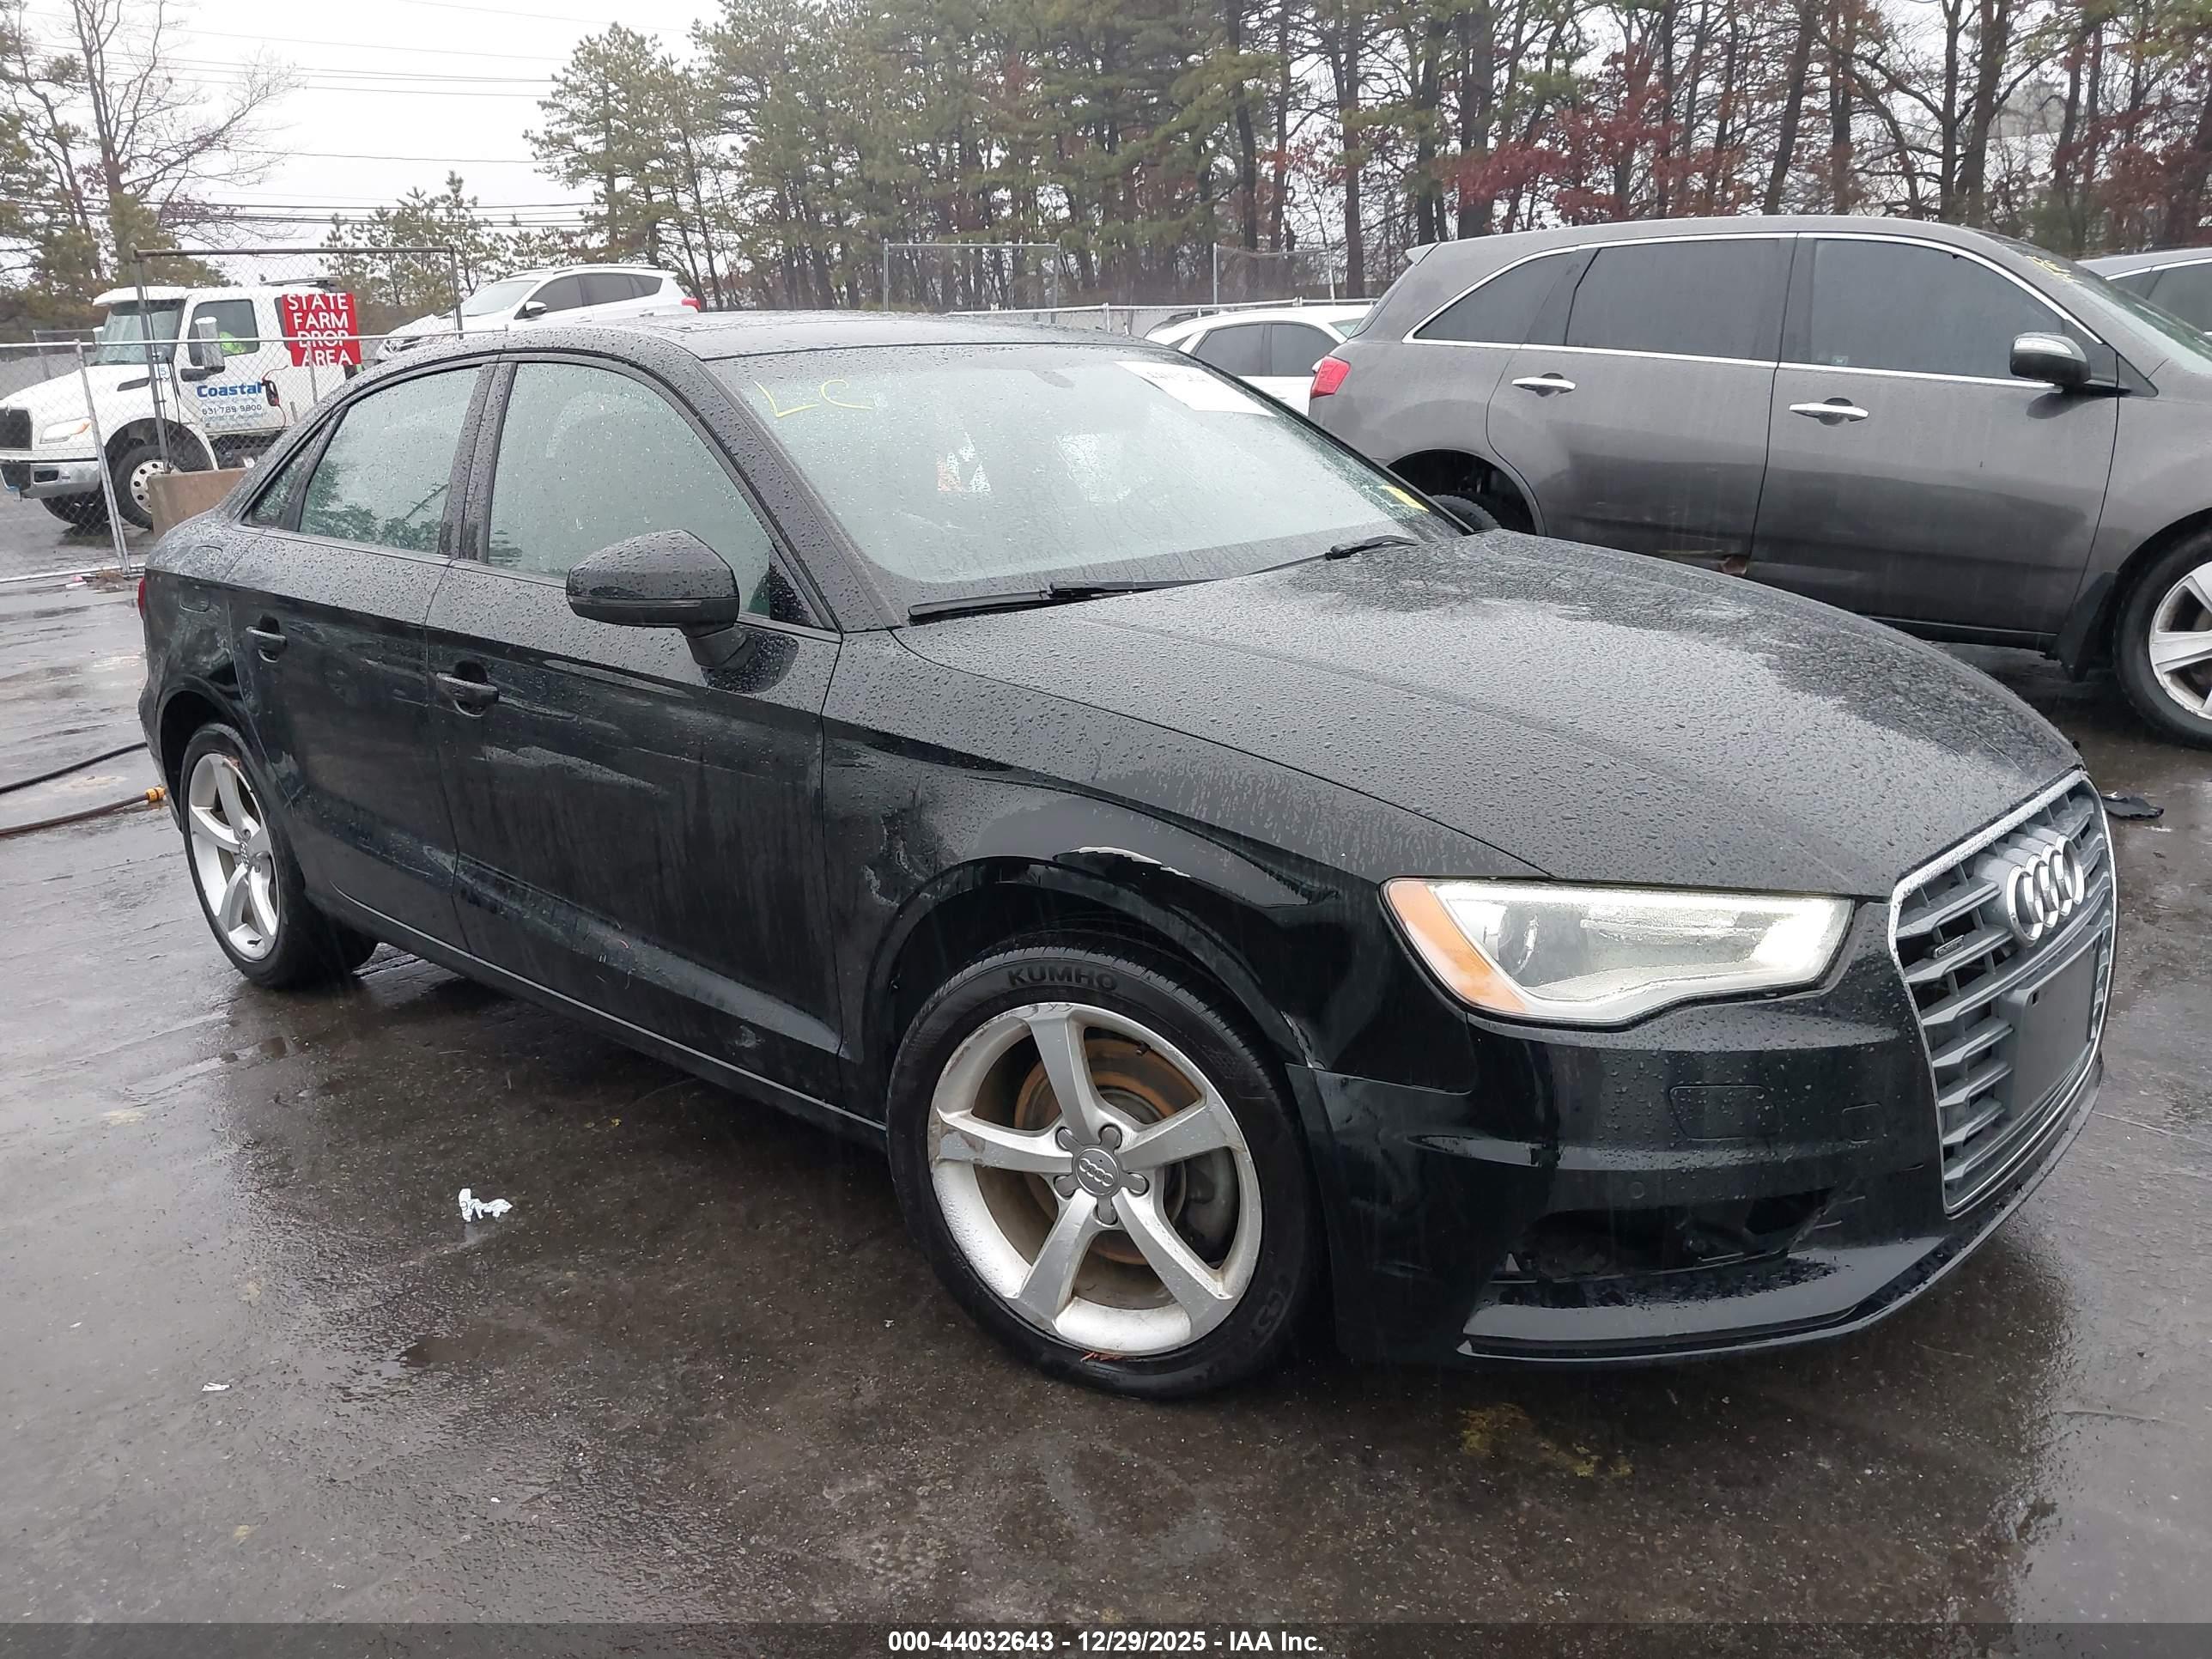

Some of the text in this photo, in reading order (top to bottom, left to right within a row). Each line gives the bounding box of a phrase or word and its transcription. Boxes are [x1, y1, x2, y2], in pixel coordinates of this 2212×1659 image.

[287, 293, 349, 310] STATE
[293, 312, 349, 330] FARM
[297, 330, 349, 348] DROP
[301, 349, 354, 367] AREA
[197, 381, 262, 398] Coastal
[1007, 966, 1116, 992] KUMHO
